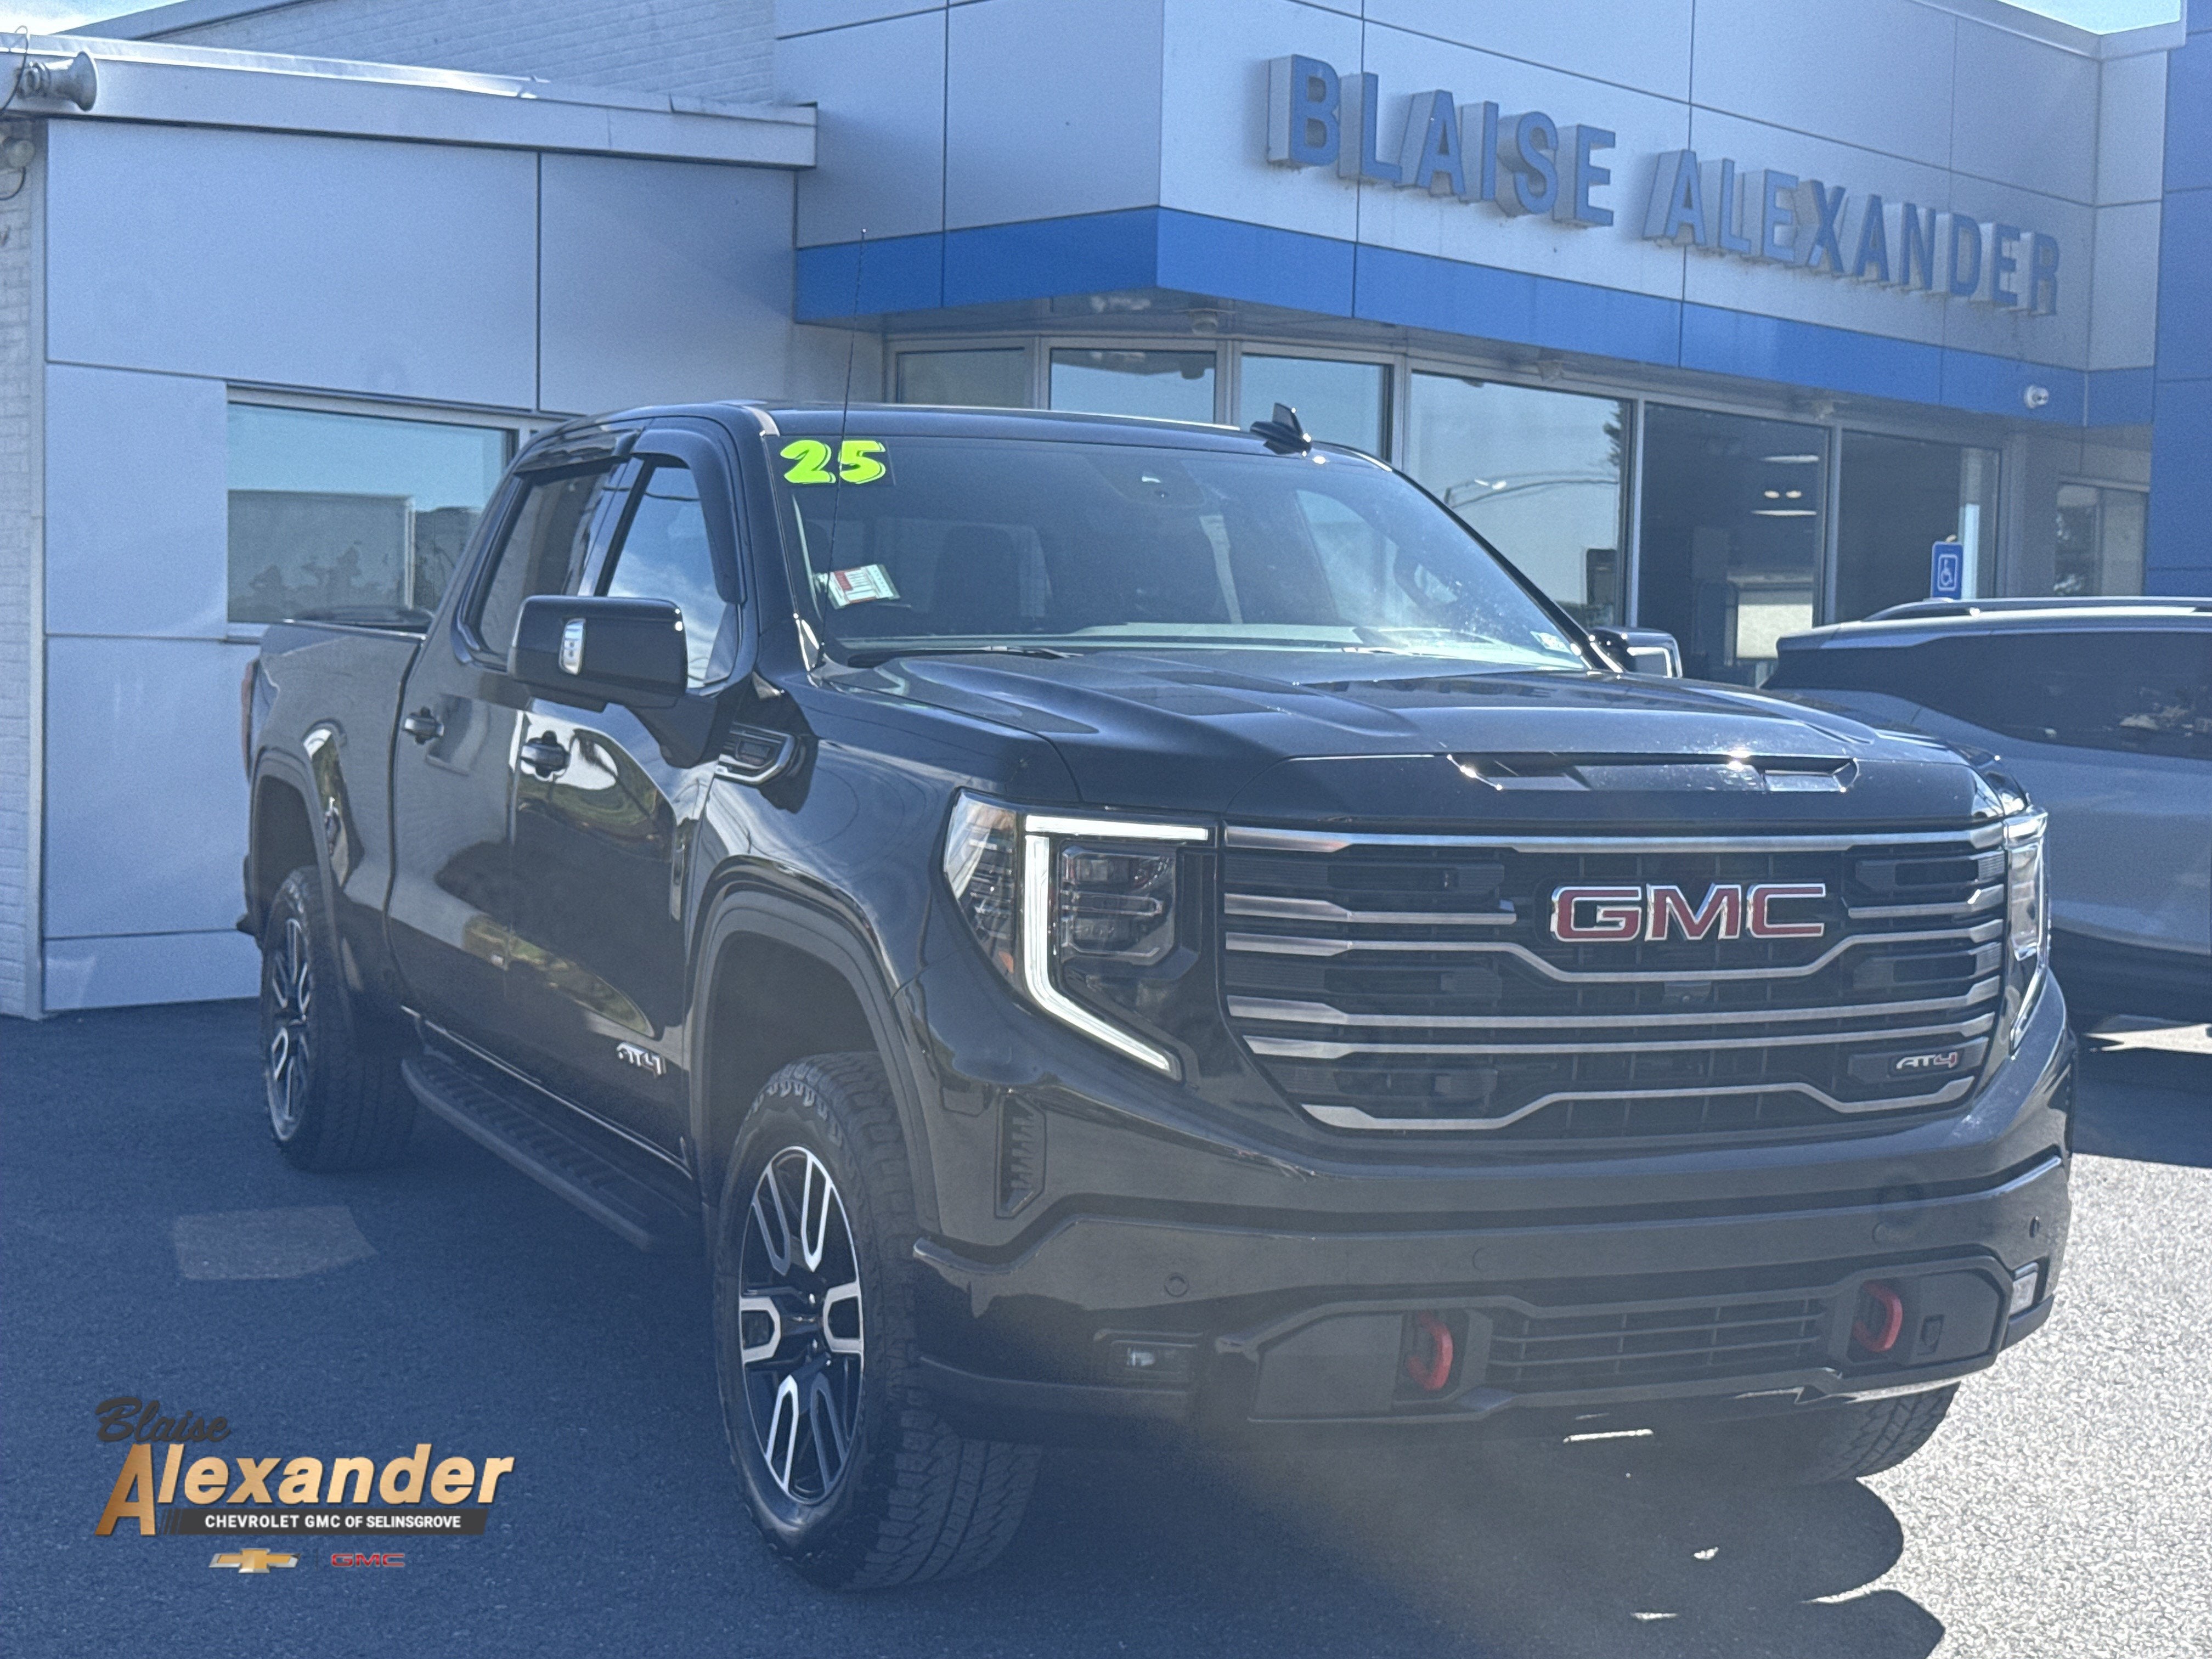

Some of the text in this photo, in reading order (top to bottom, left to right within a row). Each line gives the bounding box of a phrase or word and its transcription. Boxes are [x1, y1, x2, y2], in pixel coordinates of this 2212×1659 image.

[1288, 53, 2061, 316] BLAISE ALEXANDER
[780, 439, 886, 484] 25
[1550, 883, 1826, 942] GMC
[616, 1042, 666, 1079] AT4
[1896, 1052, 1957, 1069] AT4
